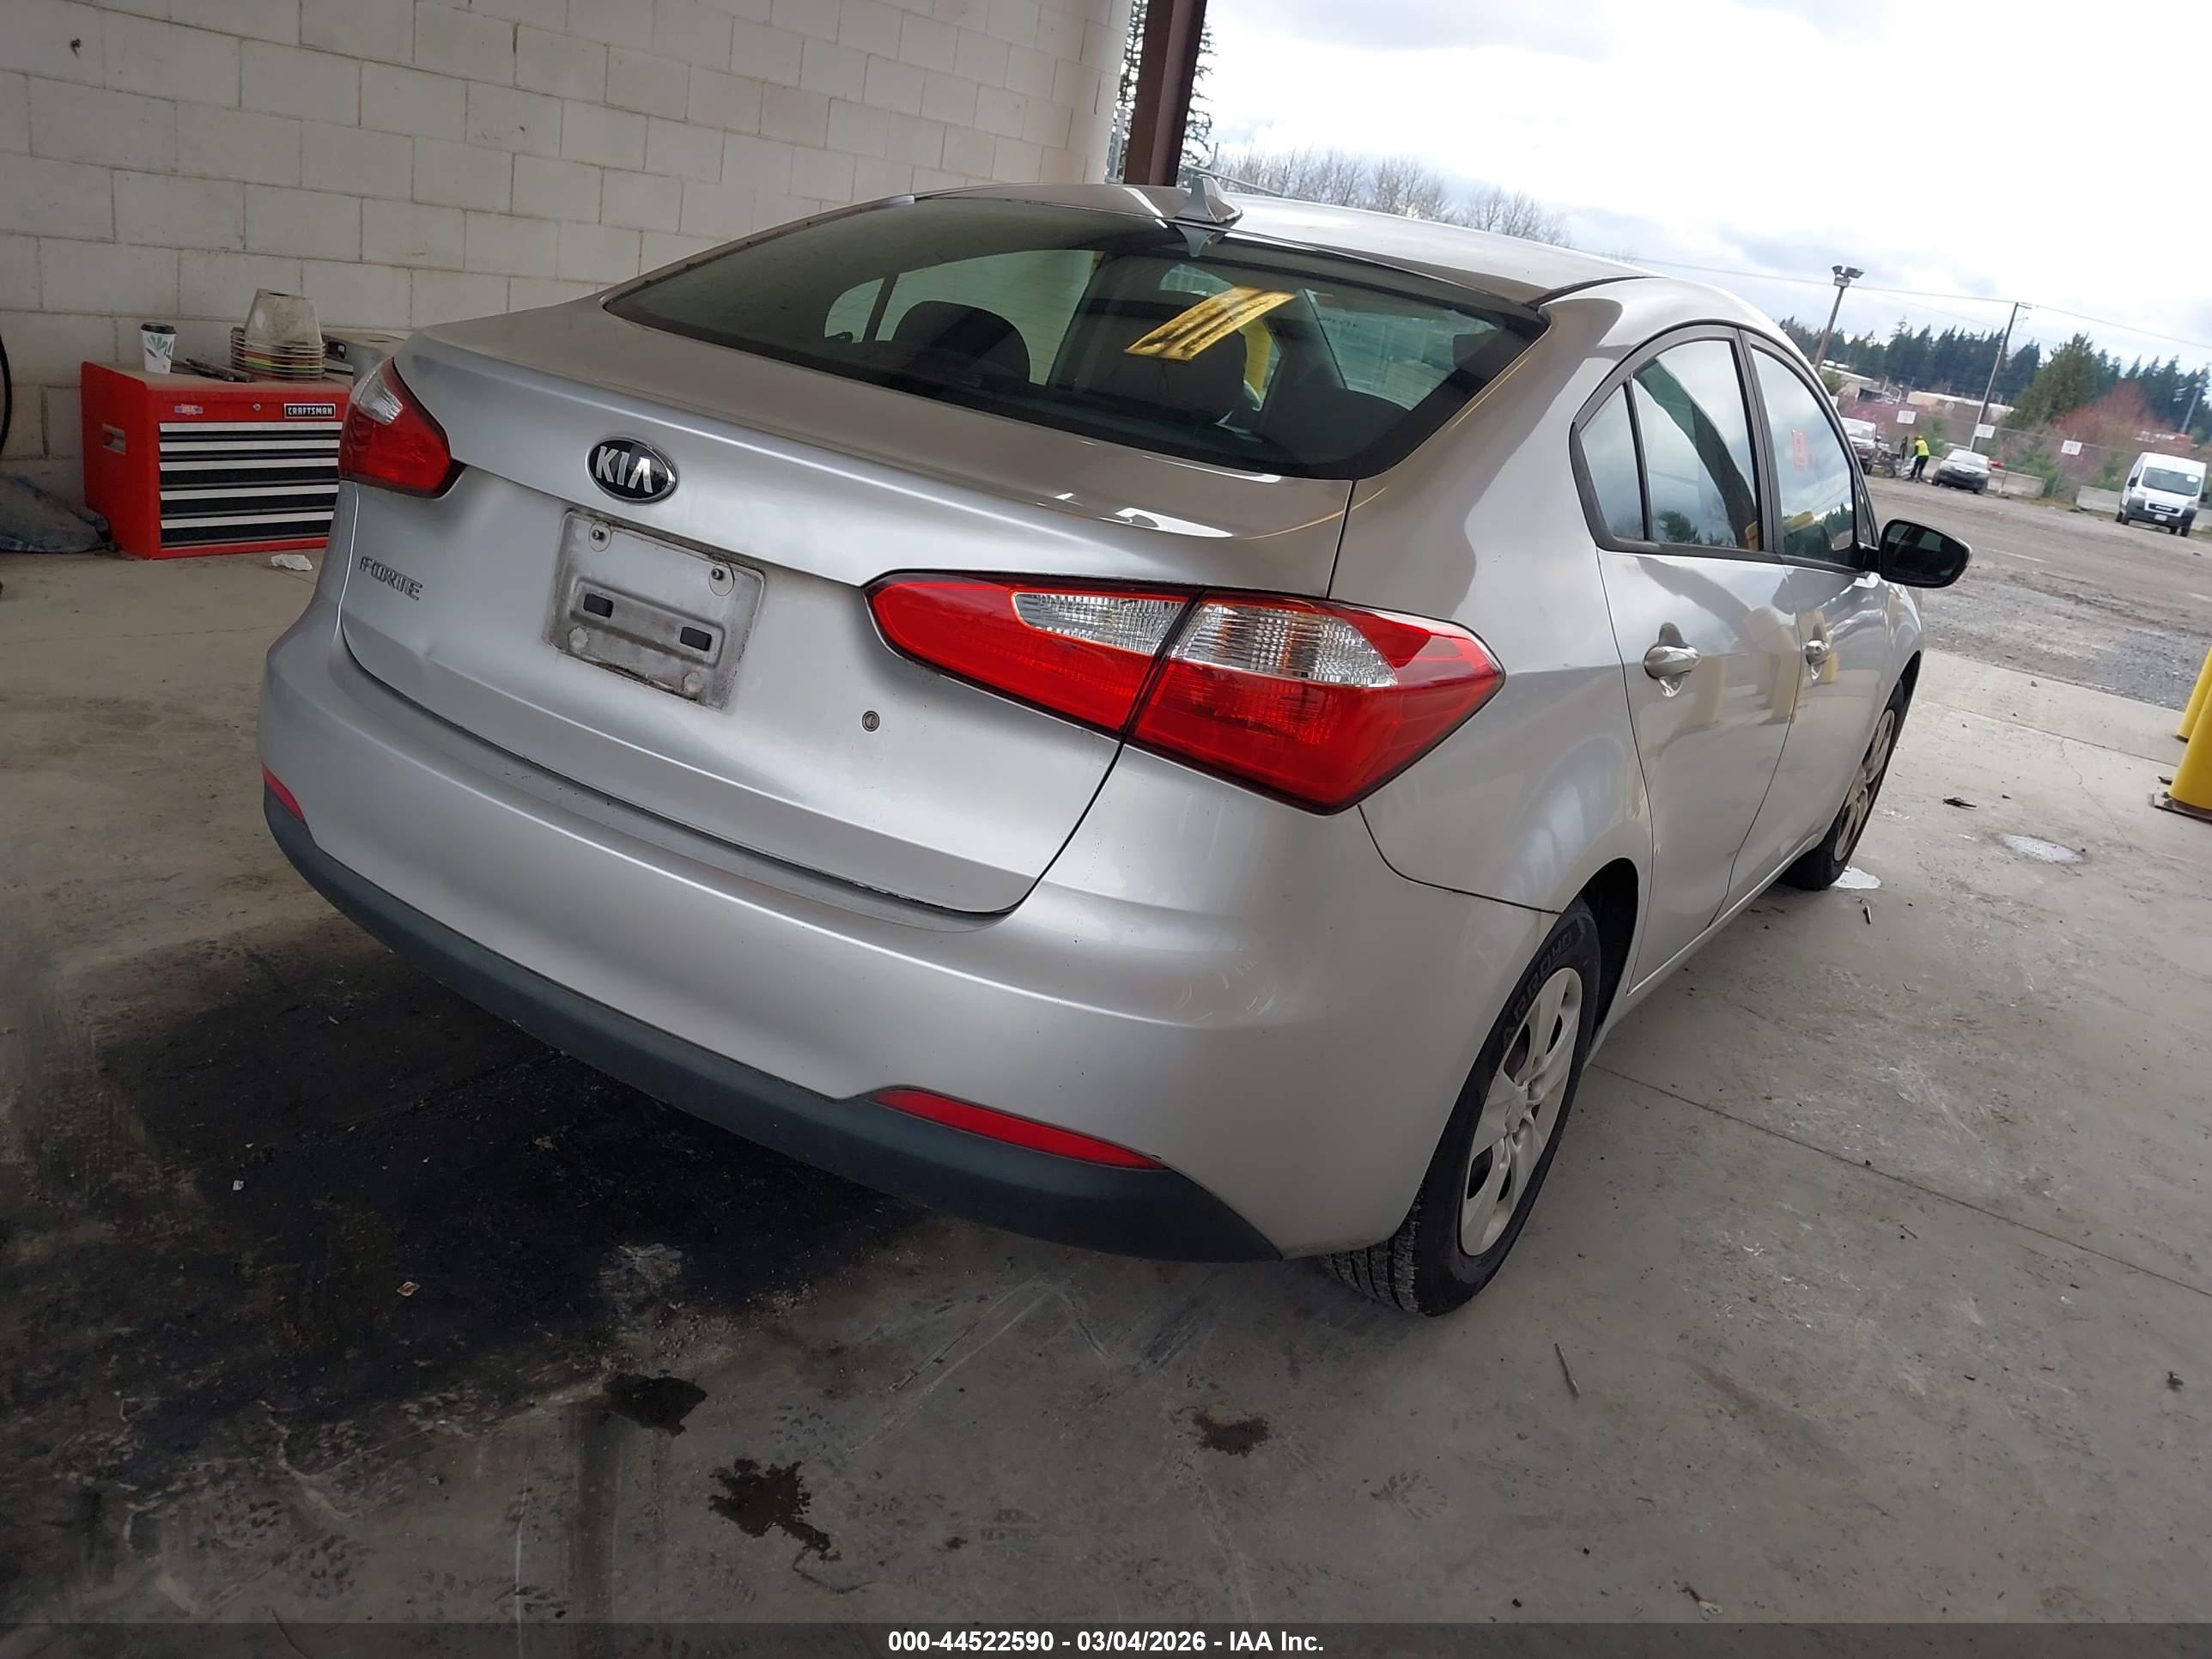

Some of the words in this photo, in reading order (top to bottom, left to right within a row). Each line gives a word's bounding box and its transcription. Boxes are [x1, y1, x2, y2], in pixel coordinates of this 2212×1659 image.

[287, 406, 333, 416] CRAFTSMAN
[595, 445, 653, 494] KIA
[359, 556, 423, 600] FORTE
